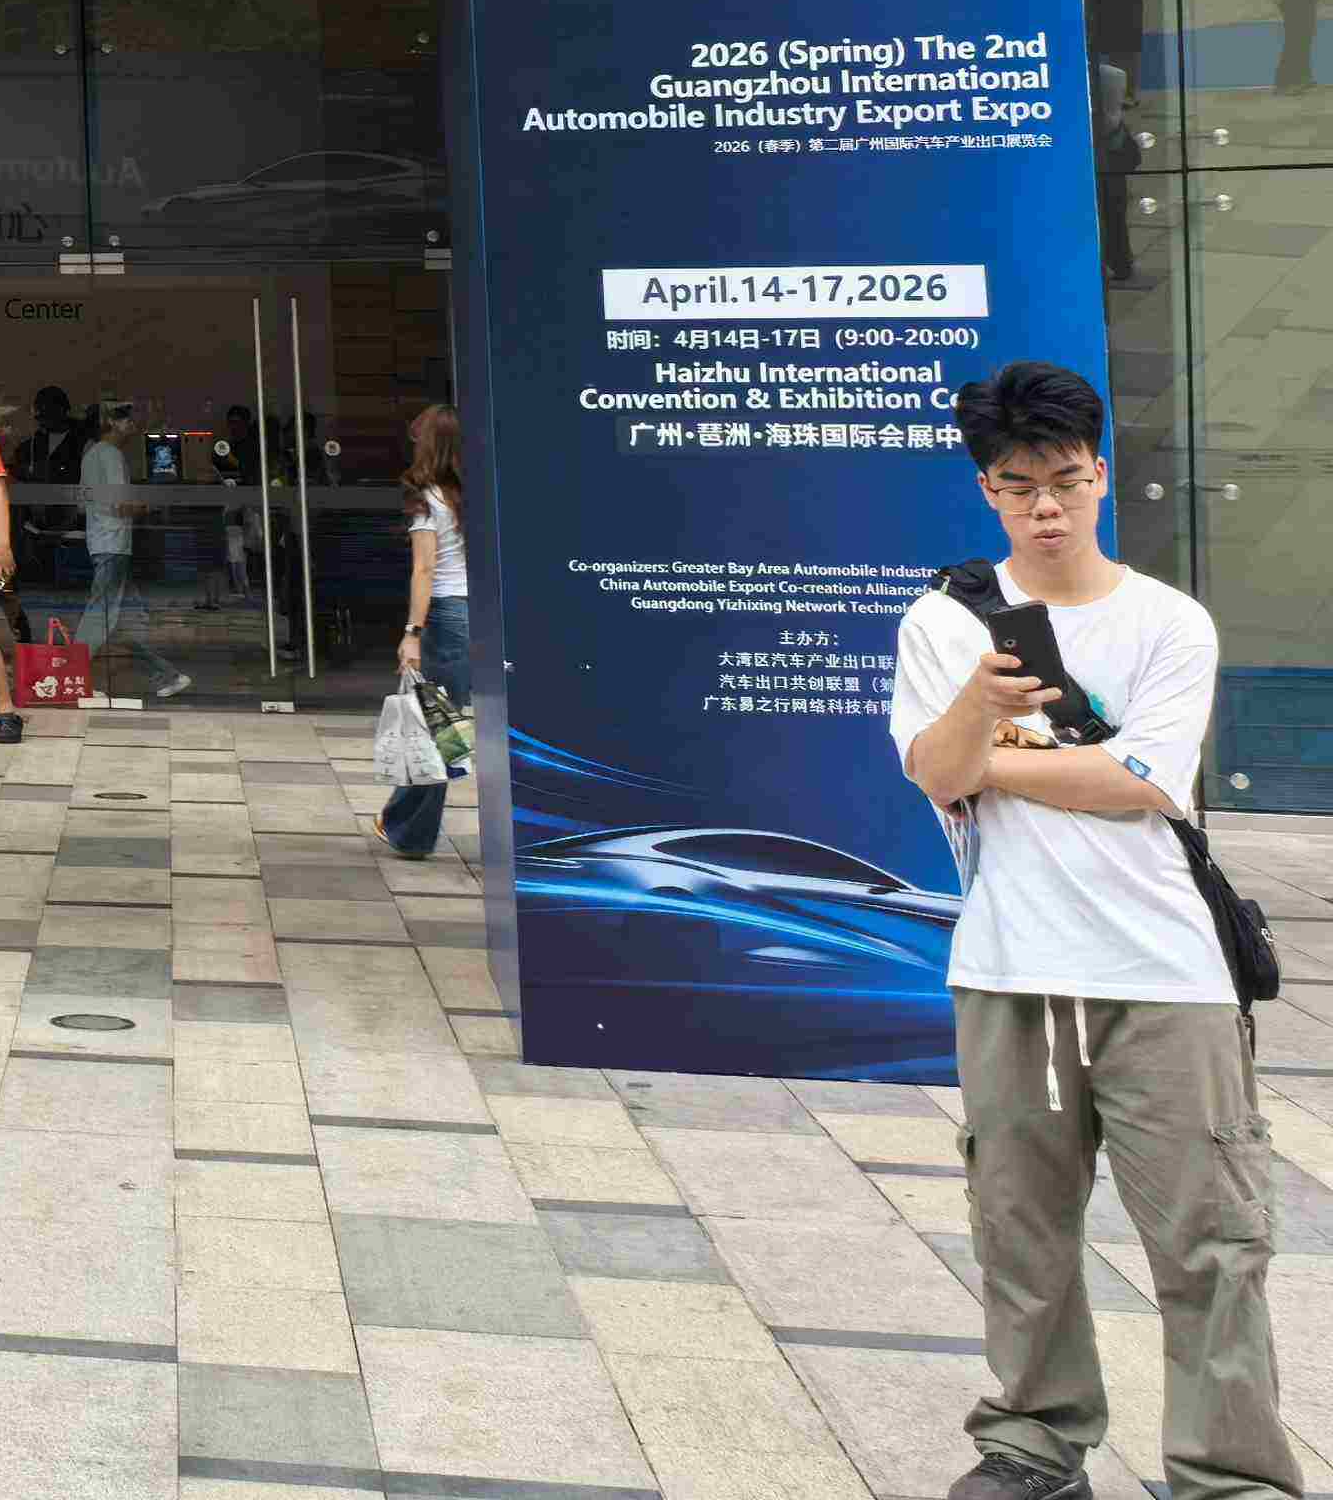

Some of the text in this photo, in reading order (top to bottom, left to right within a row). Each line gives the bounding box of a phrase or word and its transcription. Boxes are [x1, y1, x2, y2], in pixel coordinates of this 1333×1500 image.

[691, 32, 1048, 71] 2026 (Spring) The 2nd
[650, 63, 1050, 103] Guangzhou International
[522, 98, 1053, 133] Automobile Industry Export Expo
[641, 273, 948, 311] April.14-17,2026
[4, 298, 84, 322] Center
[655, 359, 942, 383] Haizhu International
[579, 387, 737, 410] Convention
[746, 388, 772, 410] &
[780, 386, 921, 410] Exhibition
[629, 422, 963, 449] 广州·琶洲·海珠国际会展中
[568, 560, 669, 576] Co-organizers:
[672, 561, 724, 575] Greater
[728, 562, 754, 579] Bay
[757, 562, 790, 576] Area
[793, 563, 878, 577] Automobile
[599, 578, 862, 596] China Automobile Export Co-creation
[631, 597, 715, 614] Guangdong
[717, 598, 783, 614] Yizhixing
[786, 599, 847, 614] Network
